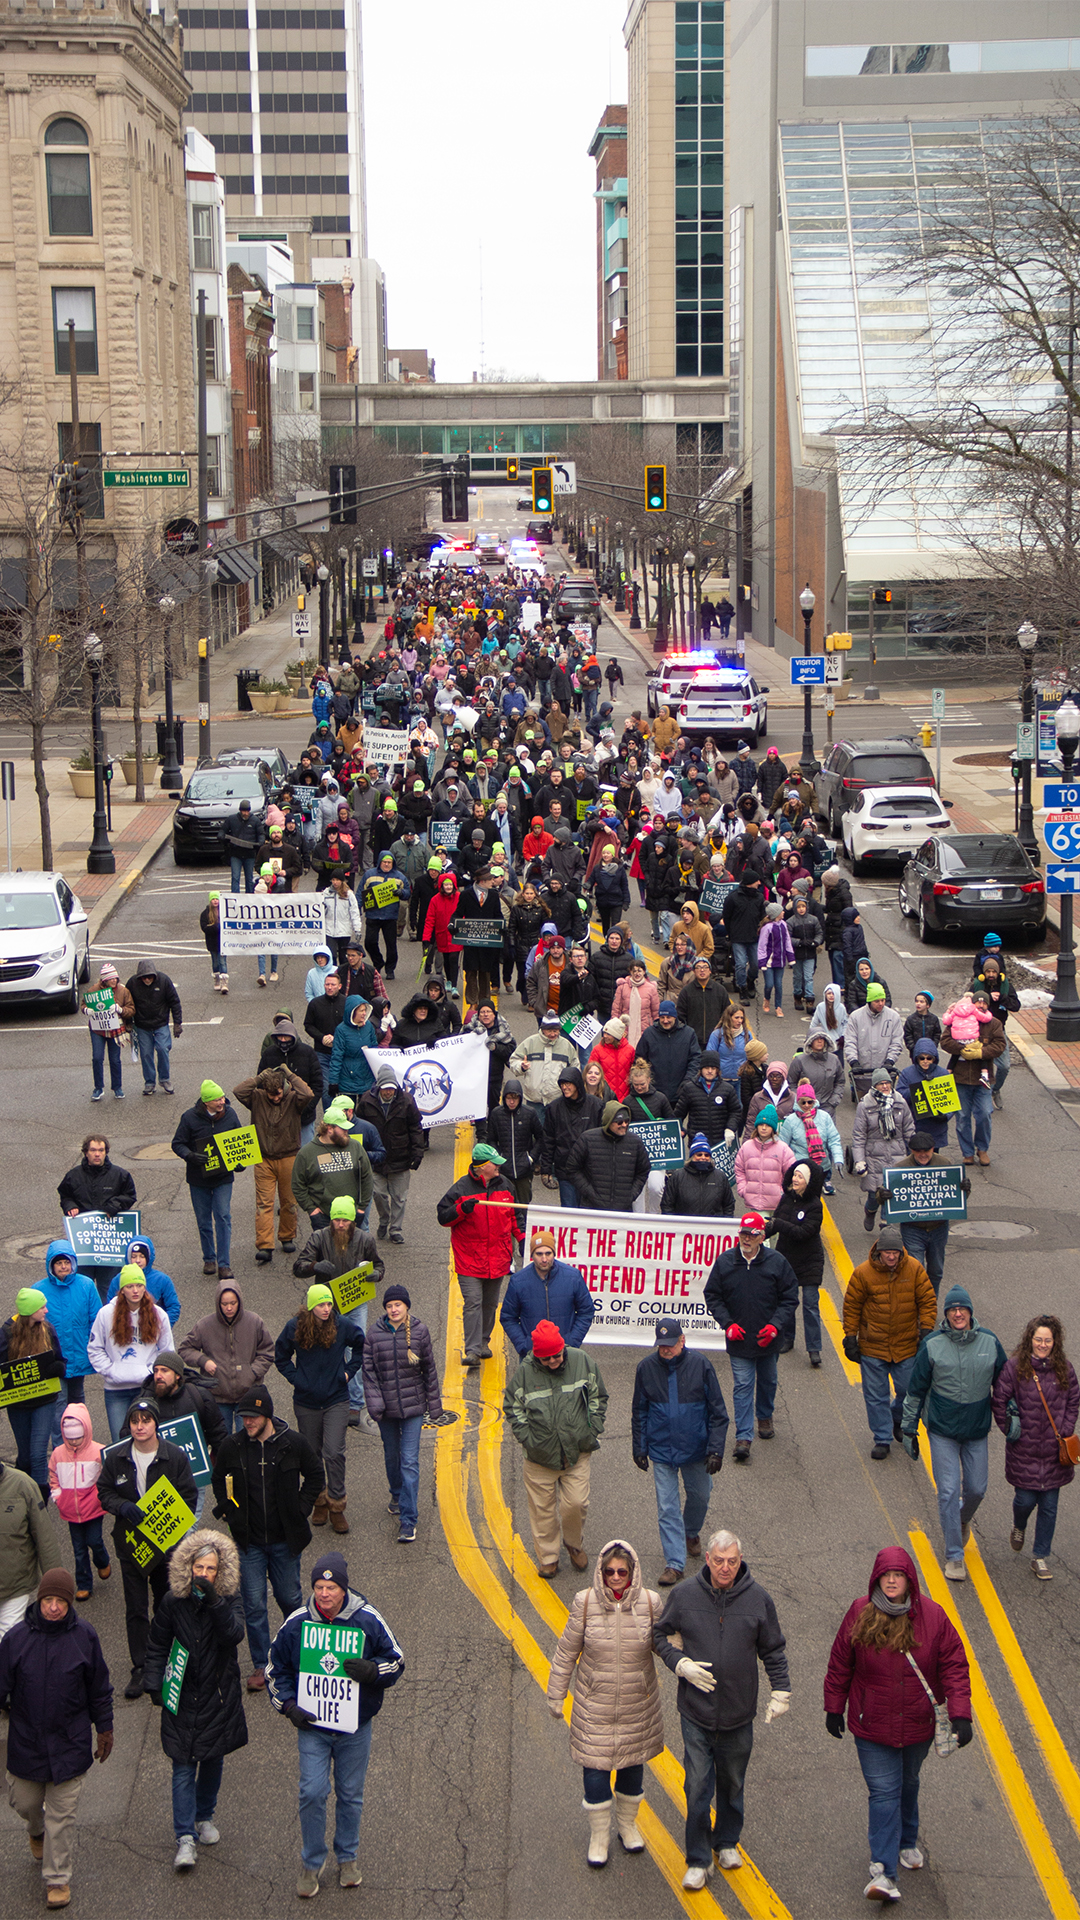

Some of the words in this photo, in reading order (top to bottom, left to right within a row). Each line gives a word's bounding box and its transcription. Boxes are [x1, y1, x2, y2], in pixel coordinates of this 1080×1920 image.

[115, 473, 163, 485] Washington
[168, 473, 186, 483] Blvd
[554, 484, 573, 492] ONLY
[827, 657, 838, 665] NE
[1023, 727, 1030, 735] P
[371, 742, 407, 751] SUPPORT
[371, 752, 393, 760] LIFE!!
[1058, 789, 1078, 802] TO
[1051, 823, 1080, 851] 69
[224, 898, 322, 919] Emmaus
[225, 921, 320, 929] LUTHERAN
[223, 940, 266, 949] Courageously
[268, 940, 302, 949] Confessing
[85, 992, 99, 1003] LOVE
[100, 989, 113, 1001] LIFE
[570, 1004, 583, 1015] LIFE
[99, 1020, 111, 1029] LIFE
[572, 1016, 592, 1038] CHOOSE
[583, 1027, 597, 1041] LIFE
[450, 1037, 464, 1046] LIFE
[929, 1082, 951, 1091] PLEASE
[931, 1095, 947, 1103] YOUR
[932, 1101, 954, 1109] STORY.
[431, 1117, 454, 1126] CATHOLIC
[455, 1114, 475, 1122] CHURCH
[223, 1133, 251, 1145] PLEASE
[643, 1137, 677, 1146] EPTION
[224, 1142, 242, 1151] TELL
[226, 1147, 247, 1157] YOUR
[645, 1143, 677, 1152] TURAL
[227, 1153, 254, 1164] STORY.
[901, 1171, 947, 1180] PRO-LIFE
[893, 1184, 957, 1195] CONCEPTION
[911, 1191, 957, 1200] NATURAL
[909, 1199, 942, 1208] DEATH
[83, 1216, 124, 1224] PRO-LIFE
[93, 1223, 116, 1231] FROM
[76, 1230, 133, 1239] CONCEPTION
[94, 1238, 130, 1246] NATURA
[587, 1228, 617, 1258] THE
[625, 1231, 676, 1261] RIGHT
[93, 1245, 121, 1253] DEATH
[338, 1270, 368, 1289] PLEASE
[339, 1282, 358, 1295] TELL
[340, 1286, 361, 1301] YOUR
[341, 1290, 368, 1308] STORY.
[610, 1299, 632, 1312] OF
[638, 1301, 713, 1317] COLUMB
[605, 1315, 630, 1325] CHURCH
[637, 1317, 659, 1326] FATHER
[691, 1319, 717, 1330] COUNCIL
[10, 1359, 38, 1373] LCMS
[11, 1366, 40, 1382] LIFE
[13, 1375, 41, 1386] MINISTRY
[143, 1489, 168, 1517] LEASE
[145, 1509, 164, 1528] TELL
[162, 1495, 176, 1510] ME
[151, 1512, 172, 1536] YOUR
[157, 1515, 184, 1544] STORY.
[132, 1541, 147, 1558] LCMS
[136, 1546, 153, 1565] LIFE
[303, 1625, 331, 1651] LOVE
[335, 1629, 358, 1654] LIFE
[172, 1648, 186, 1682] LOVE
[306, 1675, 352, 1701] CHOOSE
[167, 1682, 180, 1711] LIFE
[317, 1700, 339, 1723] LIFE
